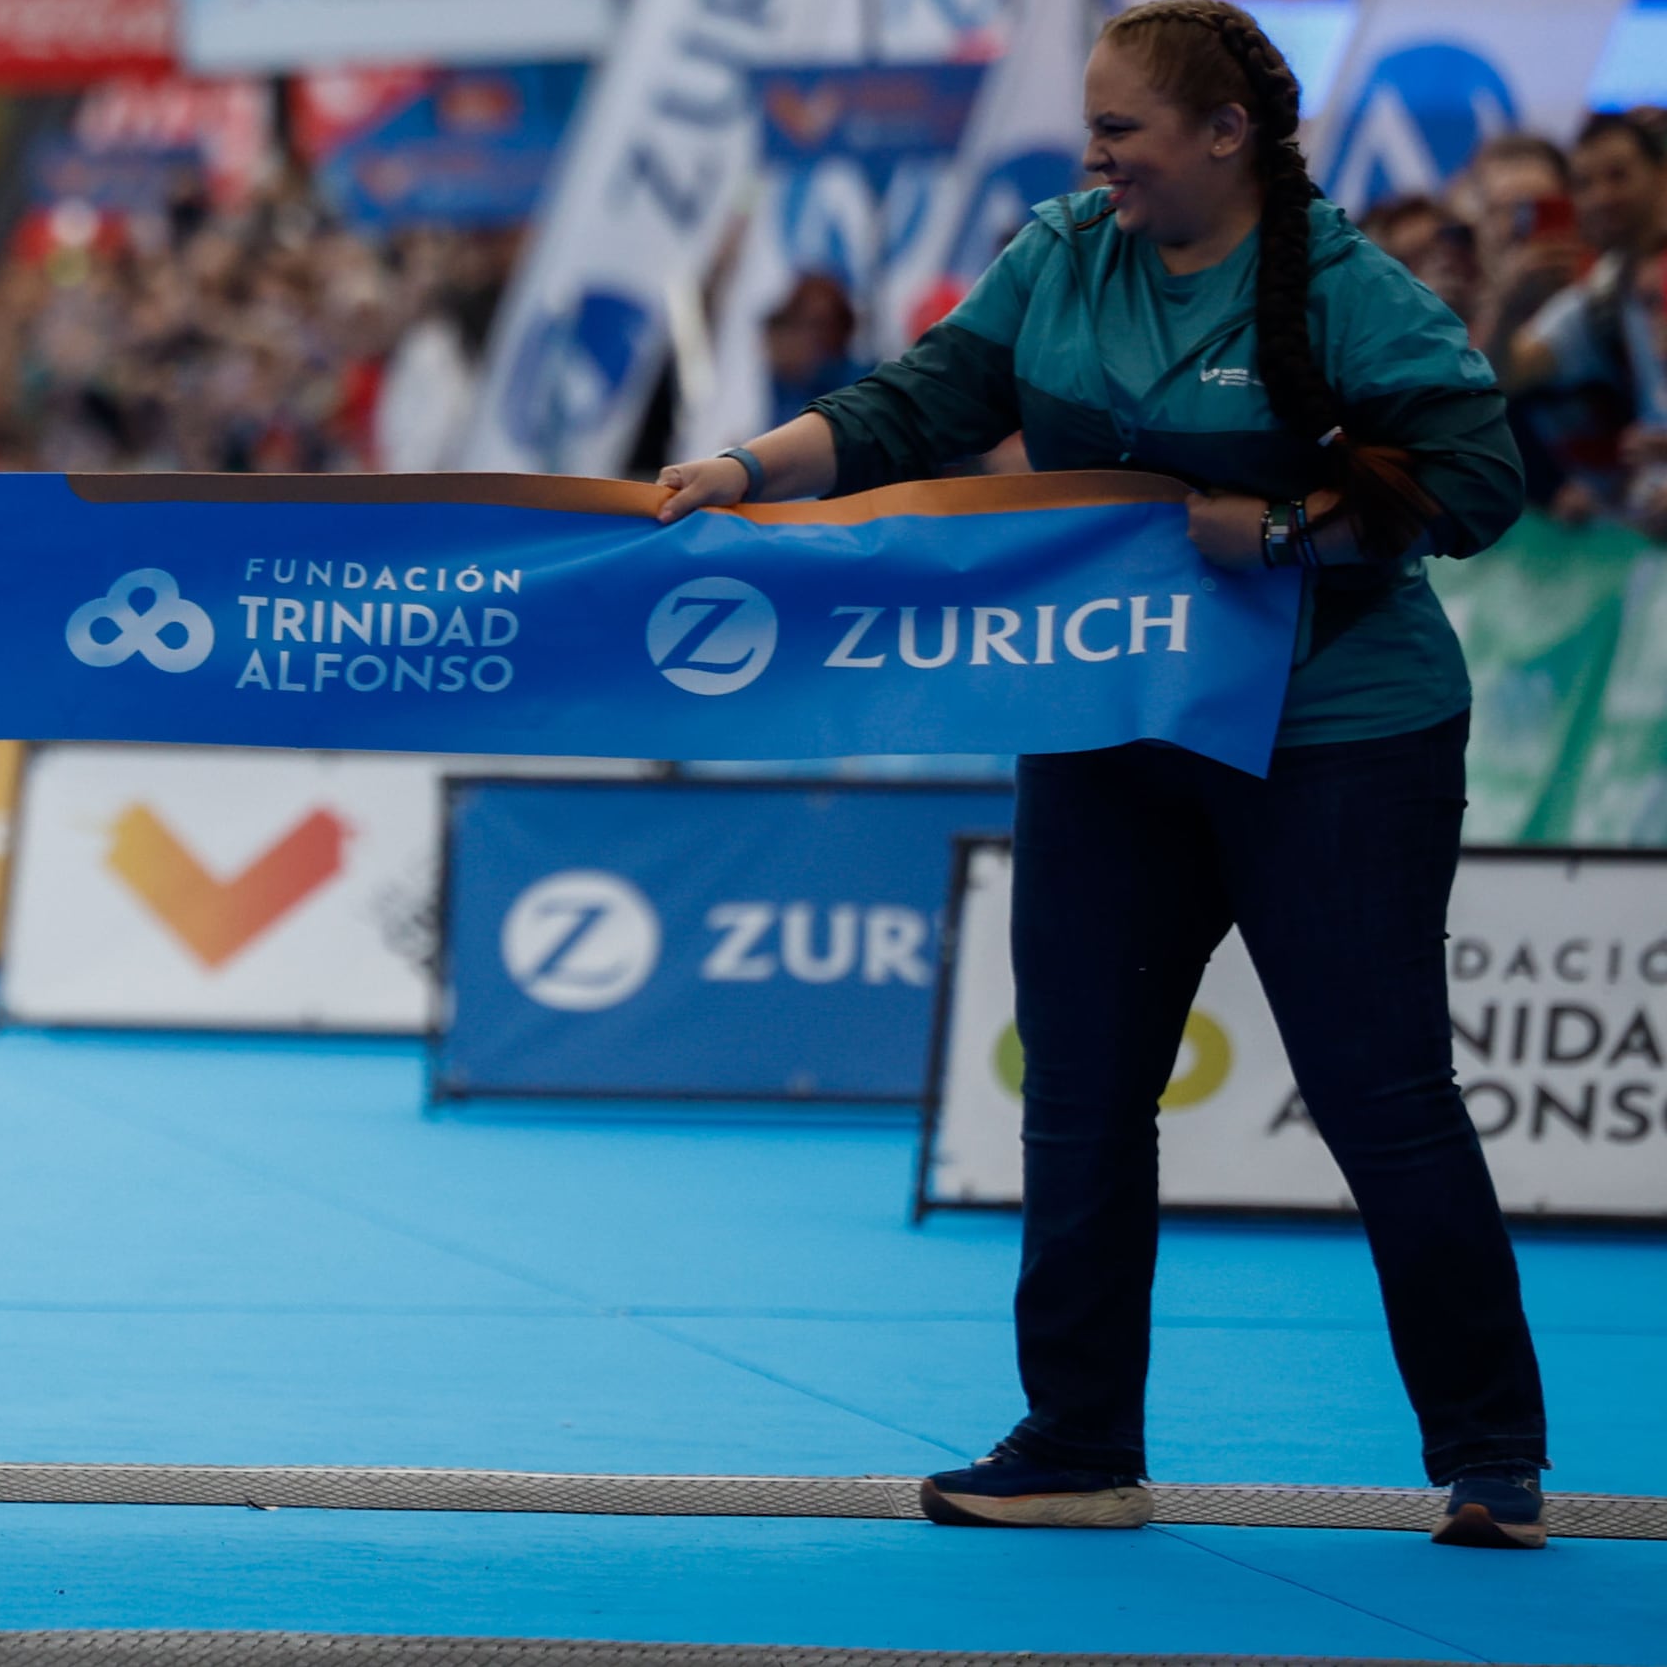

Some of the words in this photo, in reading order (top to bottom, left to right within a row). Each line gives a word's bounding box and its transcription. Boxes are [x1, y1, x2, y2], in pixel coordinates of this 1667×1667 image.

[245, 557, 522, 594] FUNDACIÓN
[238, 595, 520, 647] TRINIDAD
[822, 594, 1192, 669] ZURICH
[235, 648, 514, 692] ALFONSO
[700, 900, 939, 988] ZUR
